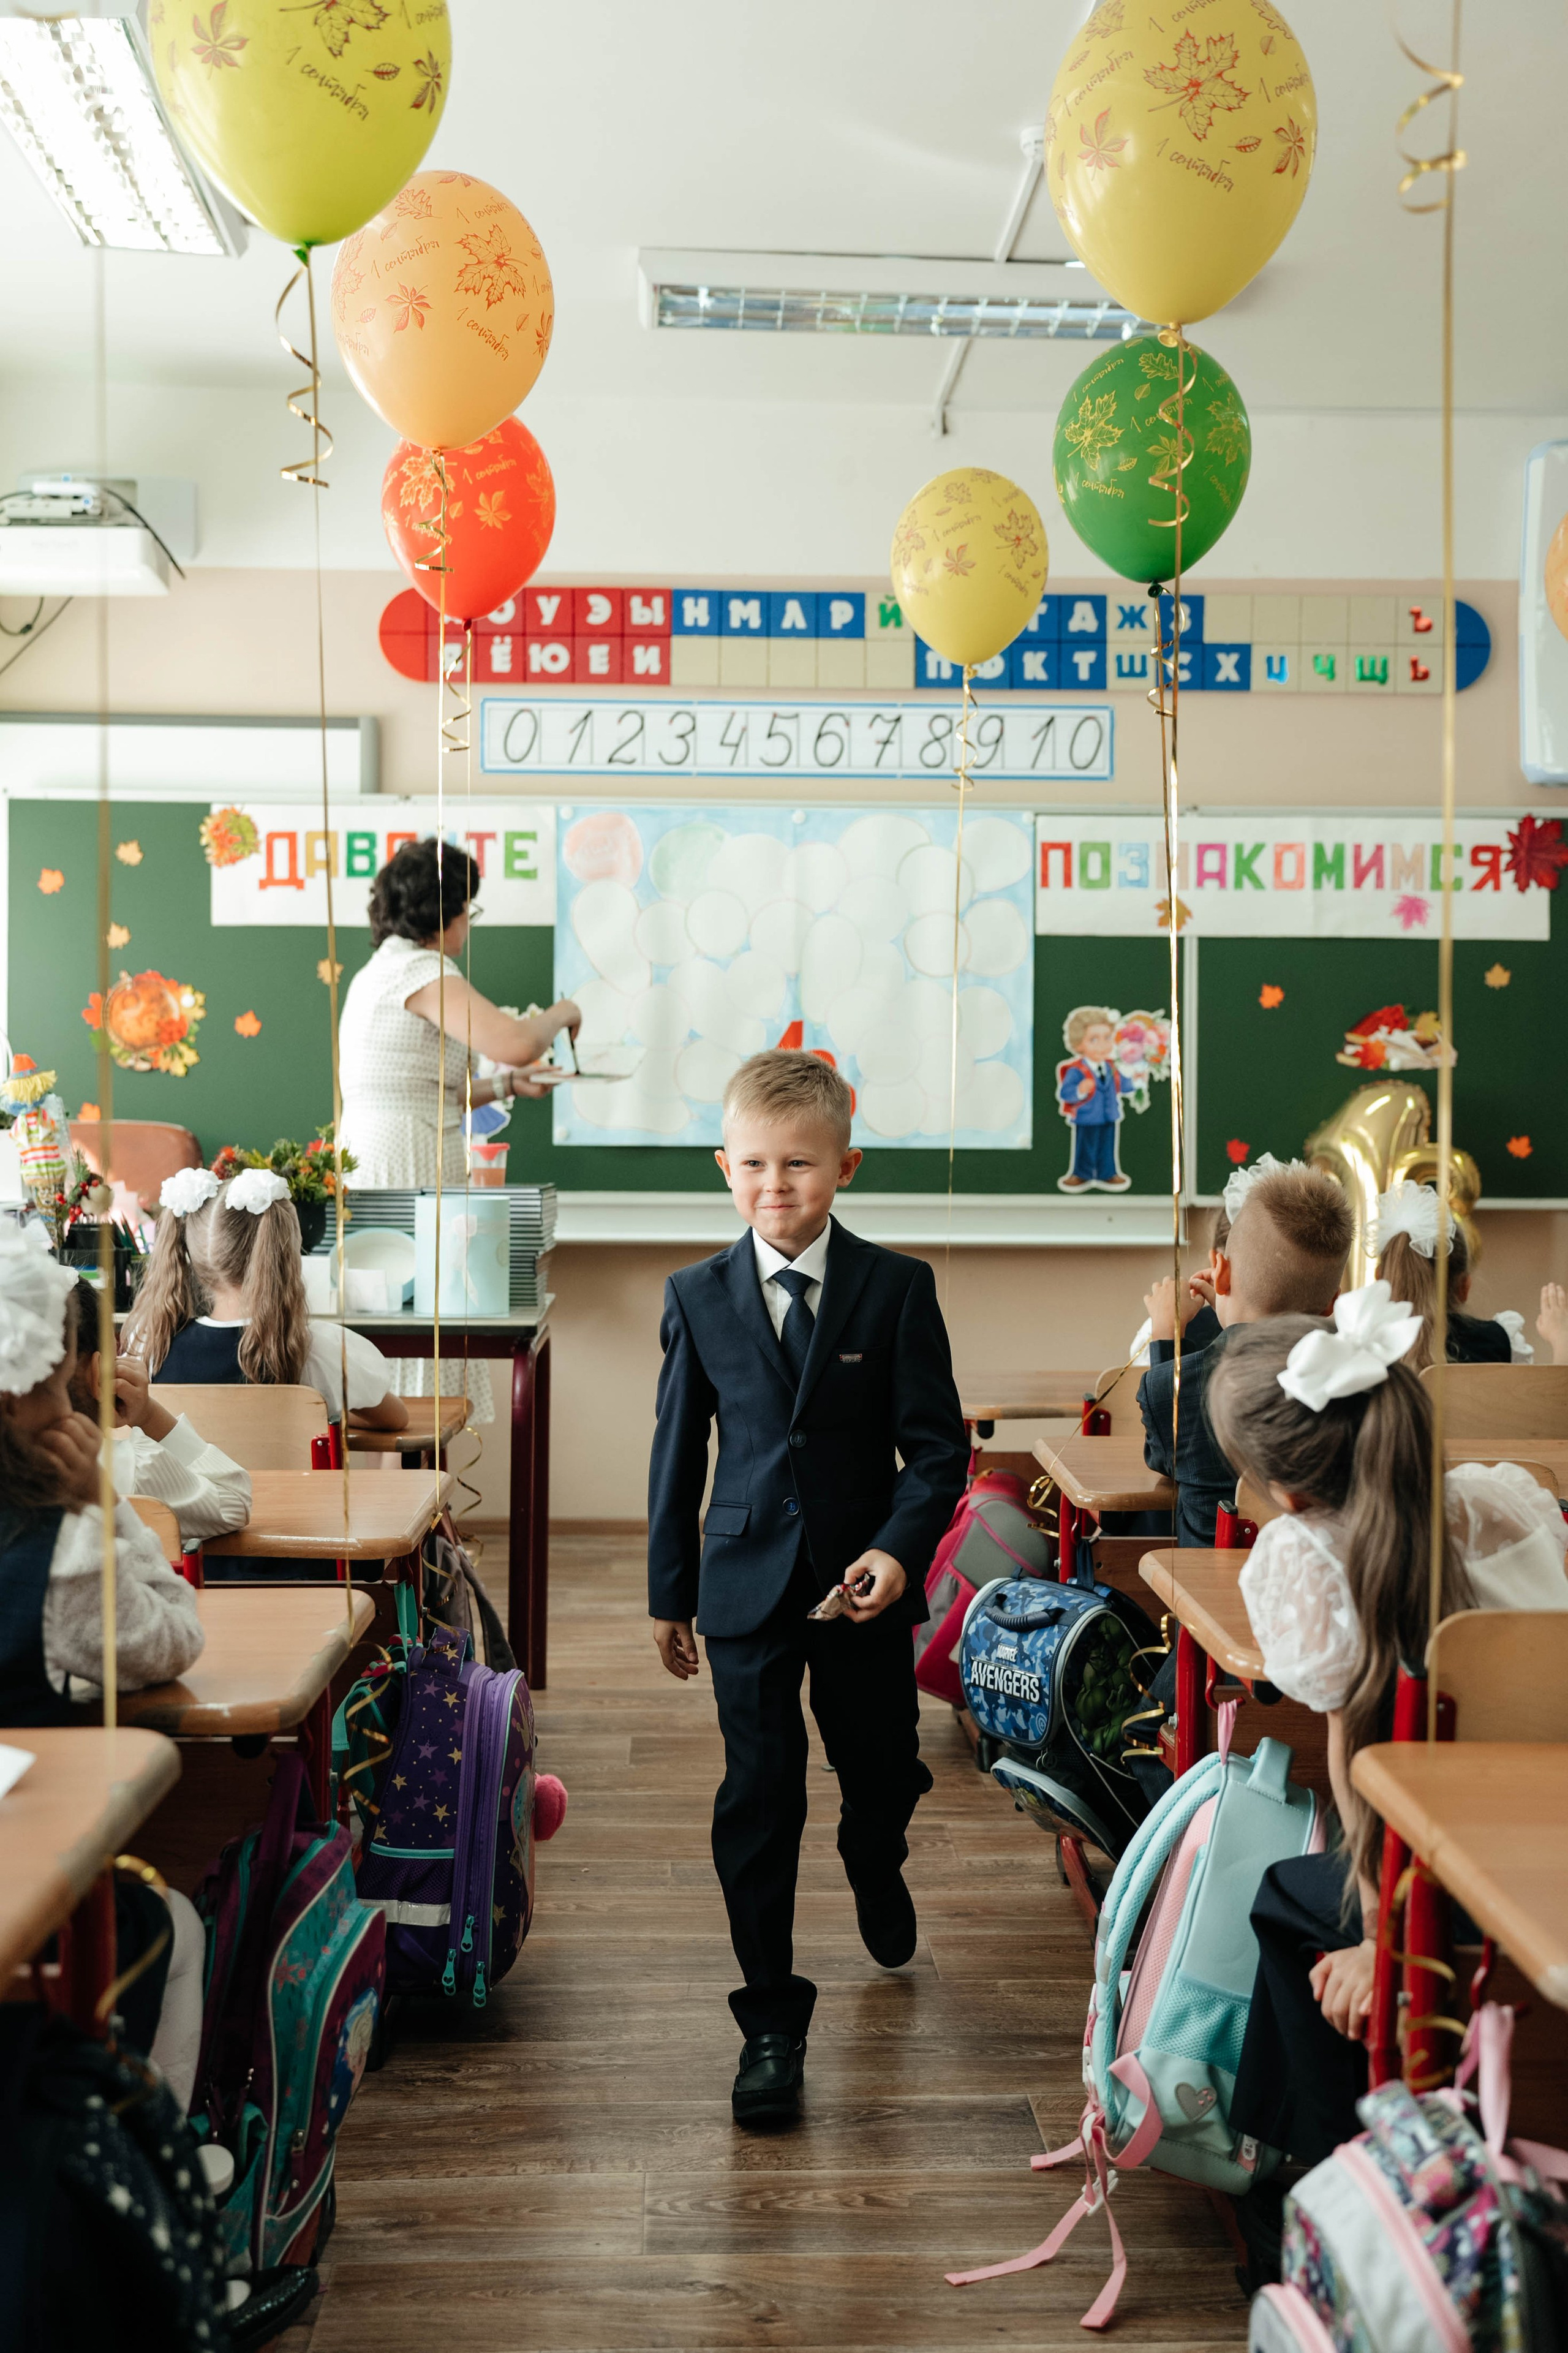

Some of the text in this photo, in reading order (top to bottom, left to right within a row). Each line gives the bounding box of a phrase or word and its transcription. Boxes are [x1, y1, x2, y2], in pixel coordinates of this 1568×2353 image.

[1149, 17, 1165, 33] 1
[286, 46, 369, 121] 1 сентября
[1063, 50, 1134, 116] 1 сентября
[1259, 77, 1272, 103] 1
[1157, 138, 1234, 192] 1 сентября
[456, 207, 470, 224] 1
[371, 235, 440, 279] 1 сентября
[458, 307, 510, 361] 1 сентября
[1071, 358, 1125, 402] 1 сентября
[1202, 377, 1214, 392] 1
[1130, 416, 1142, 432] 1
[463, 468, 473, 485] 1
[1081, 478, 1125, 499] сентября
[931, 529, 940, 542] 1
[536, 595, 562, 625] У
[586, 594, 612, 625] Э
[630, 595, 665, 626] Ы
[682, 597, 710, 627] Н
[728, 599, 762, 629] М
[780, 599, 807, 630] Л
[829, 599, 854, 630] Р
[878, 595, 903, 628] Й
[1068, 601, 1099, 633] Д
[1117, 604, 1148, 630] Ж
[1410, 606, 1433, 633] Ъ
[491, 635, 512, 673] Ё
[529, 643, 570, 674] Ю
[588, 644, 610, 674] Е
[633, 645, 662, 675] И
[925, 649, 953, 680] П
[1022, 651, 1049, 681] К
[1072, 651, 1098, 681] Т
[1116, 654, 1148, 678] Ш
[1166, 651, 1193, 682] С
[1215, 652, 1240, 682] Х
[1265, 655, 1289, 684] Ц
[1313, 654, 1336, 681] Ч
[1355, 655, 1389, 685] Щ
[1410, 655, 1430, 682] Ь
[503, 708, 538, 763] 0
[568, 709, 593, 764] 1
[608, 710, 645, 765] 2
[658, 711, 696, 766] 3
[720, 711, 747, 766] 4
[760, 711, 800, 767] 5
[813, 712, 850, 768] 6
[868, 713, 902, 768] 7
[919, 714, 953, 769] 8
[971, 714, 1005, 769] 9
[259, 831, 538, 890] ДАВТЕ
[1040, 841, 1502, 891] ПОЗНАКОМИМСЯ
[997, 1644, 1018, 1663] MARVEL
[970, 1661, 1040, 1702] AVENGERS
